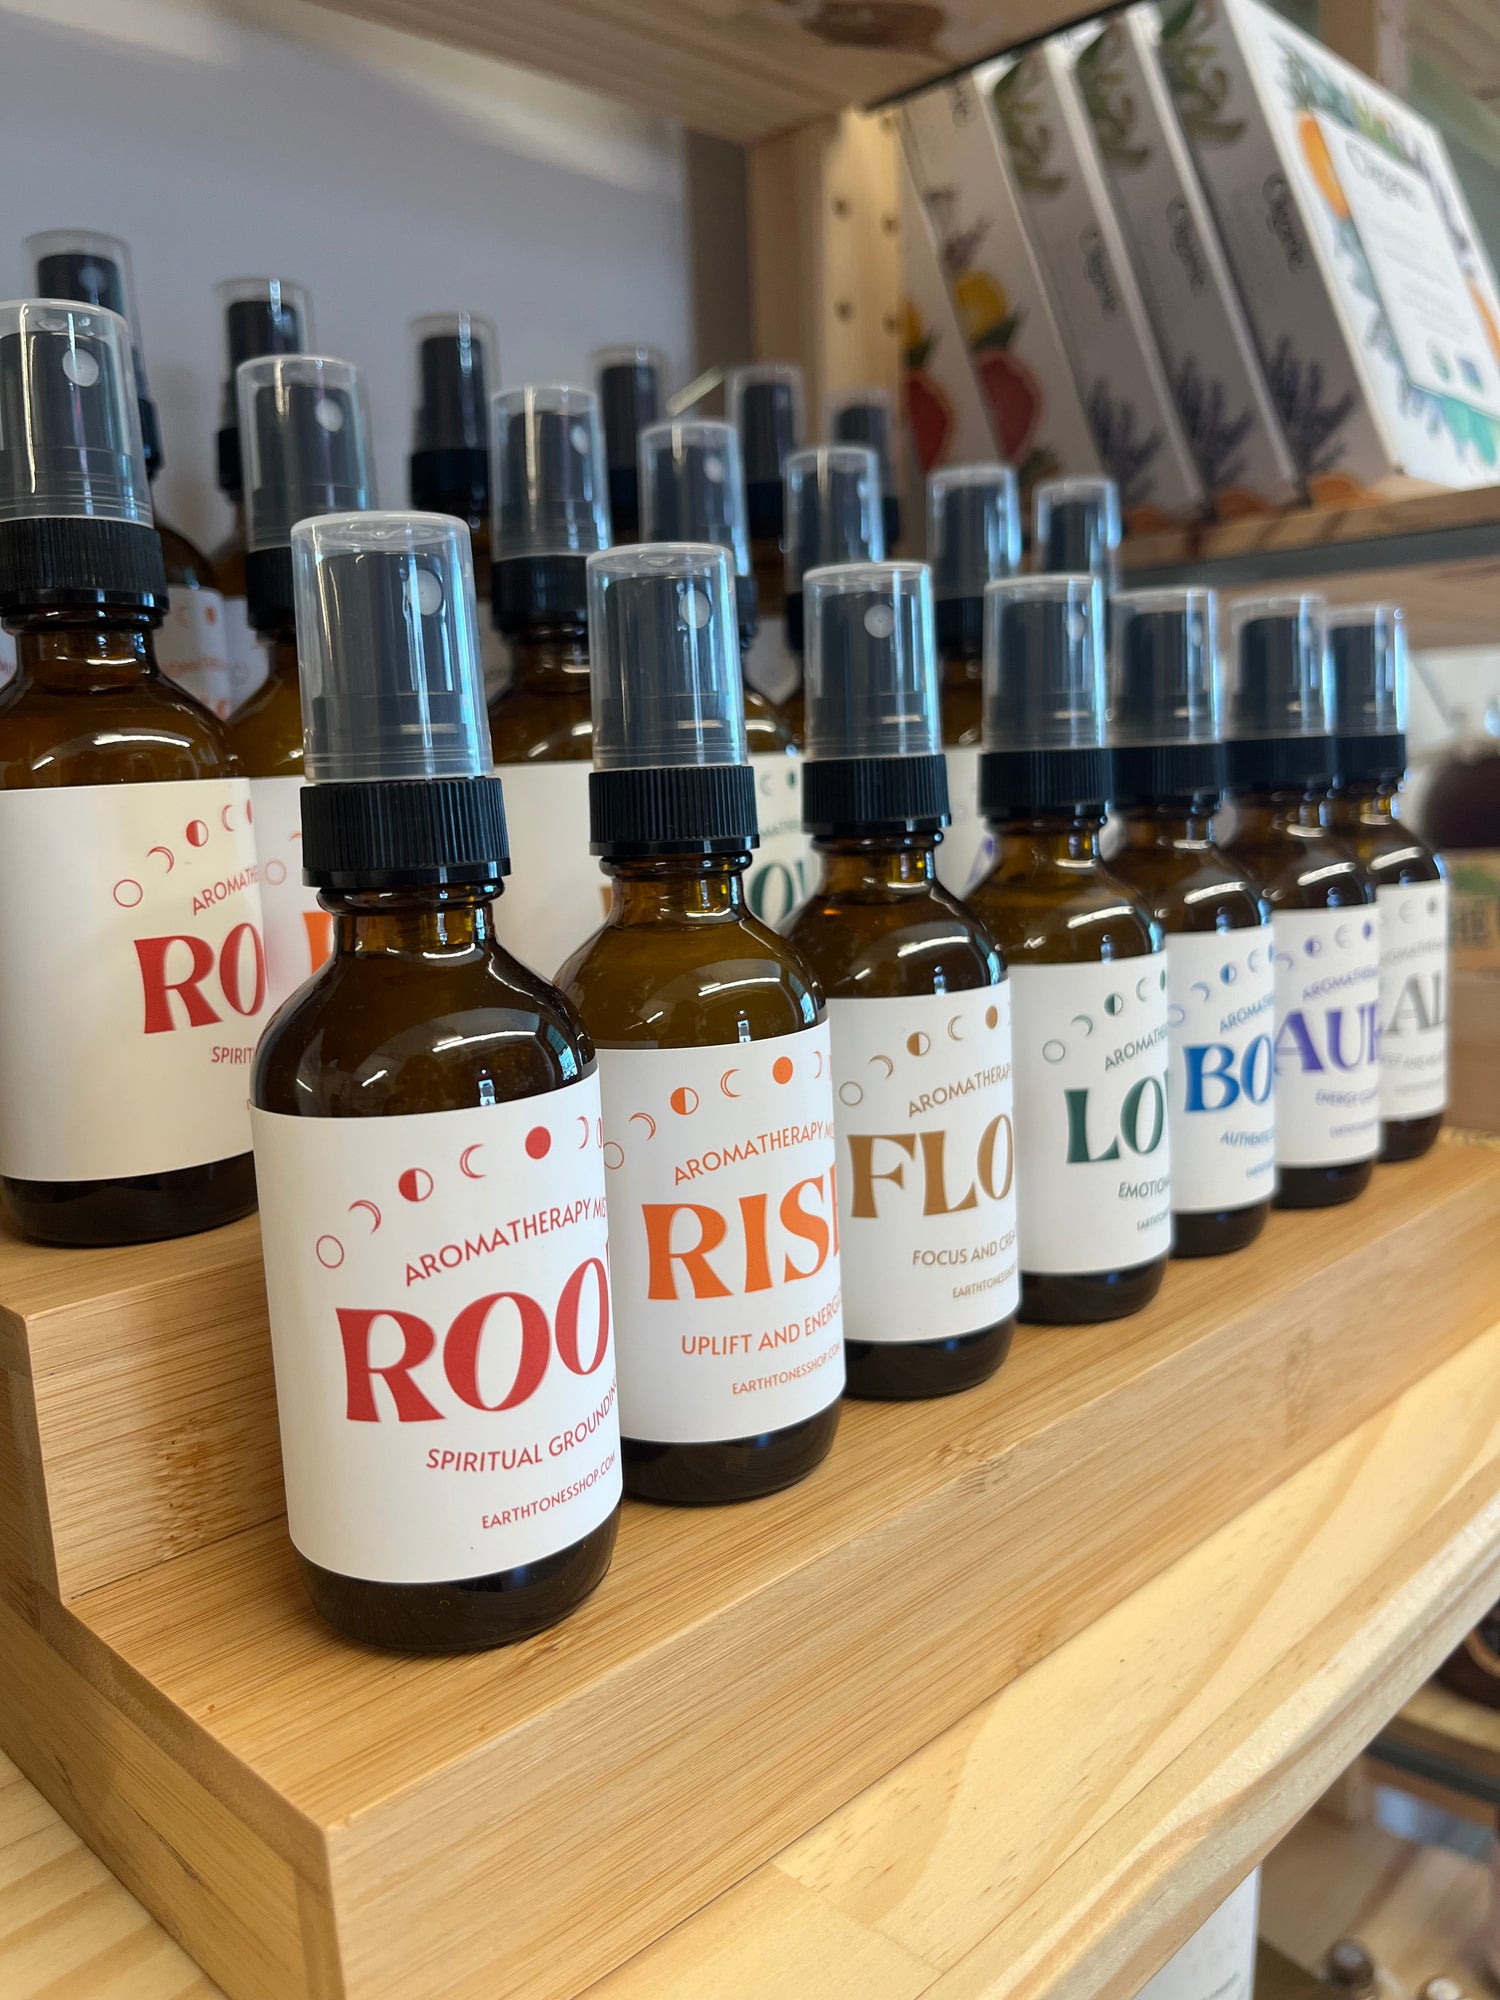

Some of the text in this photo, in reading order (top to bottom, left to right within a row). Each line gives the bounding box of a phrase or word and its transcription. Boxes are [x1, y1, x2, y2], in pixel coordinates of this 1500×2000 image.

[211, 1046, 256, 1064] SPIRIT
[674, 1120, 823, 1186] AROMATHERAPY
[1064, 1068, 1168, 1164] LO
[847, 1114, 1014, 1218] FLO
[405, 1198, 591, 1287] AROMATHERAPY
[912, 1248, 967, 1266] FOCUS
[971, 1241, 998, 1263] AND
[336, 1240, 610, 1423] ROO
[682, 1333, 752, 1356] UPLIFT
[758, 1323, 801, 1352] AND
[426, 1370, 618, 1472] SPIRITUAL GROUNDIN
[481, 1451, 616, 1530] EARTHTONESSHOP.COM
